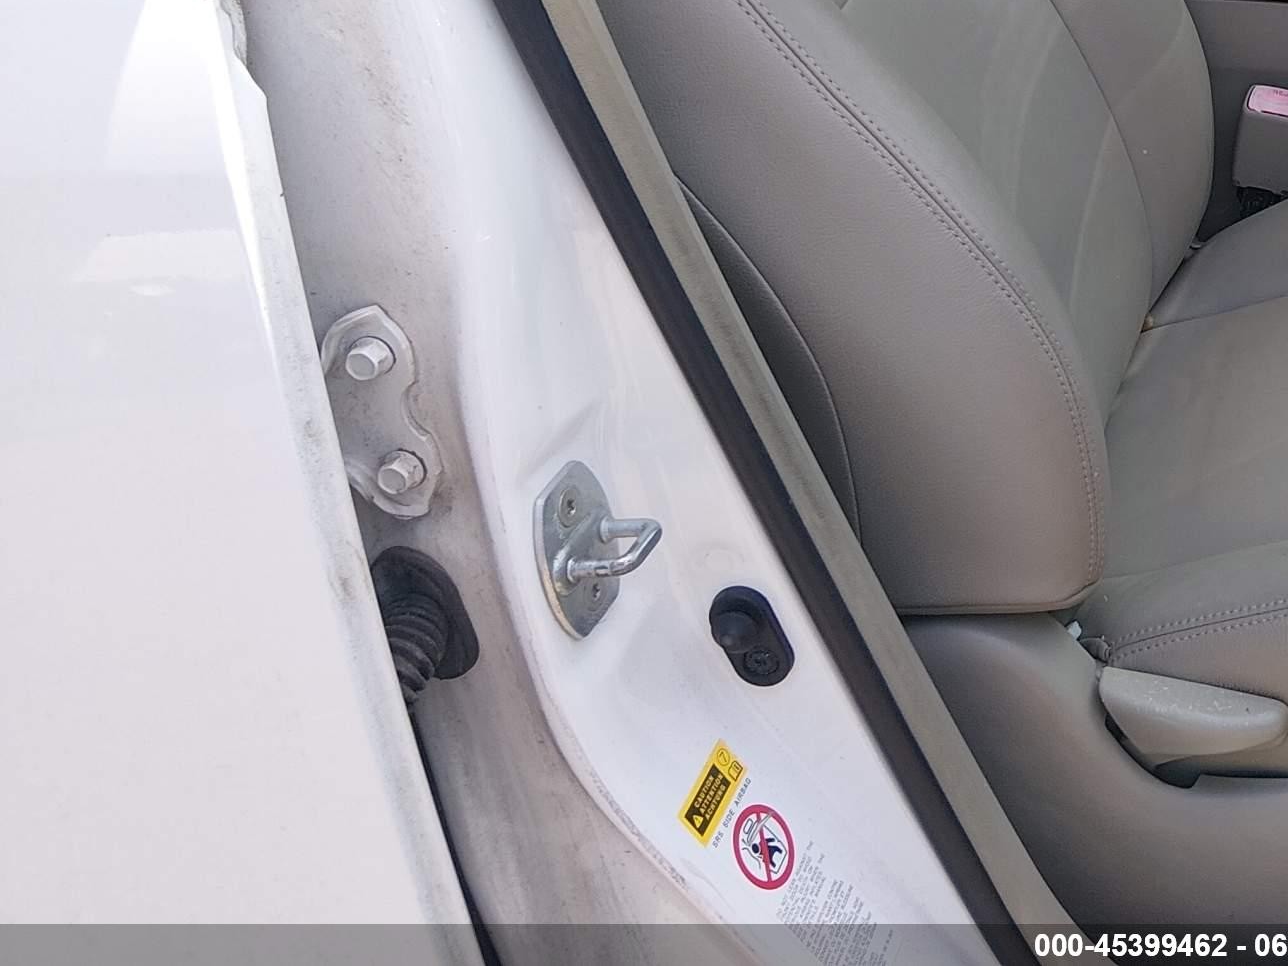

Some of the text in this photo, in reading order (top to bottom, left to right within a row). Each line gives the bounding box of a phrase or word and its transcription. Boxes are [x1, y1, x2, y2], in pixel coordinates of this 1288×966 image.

[694, 775, 715, 808] CAUTION
[700, 774, 724, 814] ATTENTION
[705, 784, 727, 820] ACHTUNG
[712, 777, 752, 848] SRS SIDE AIRBAG
